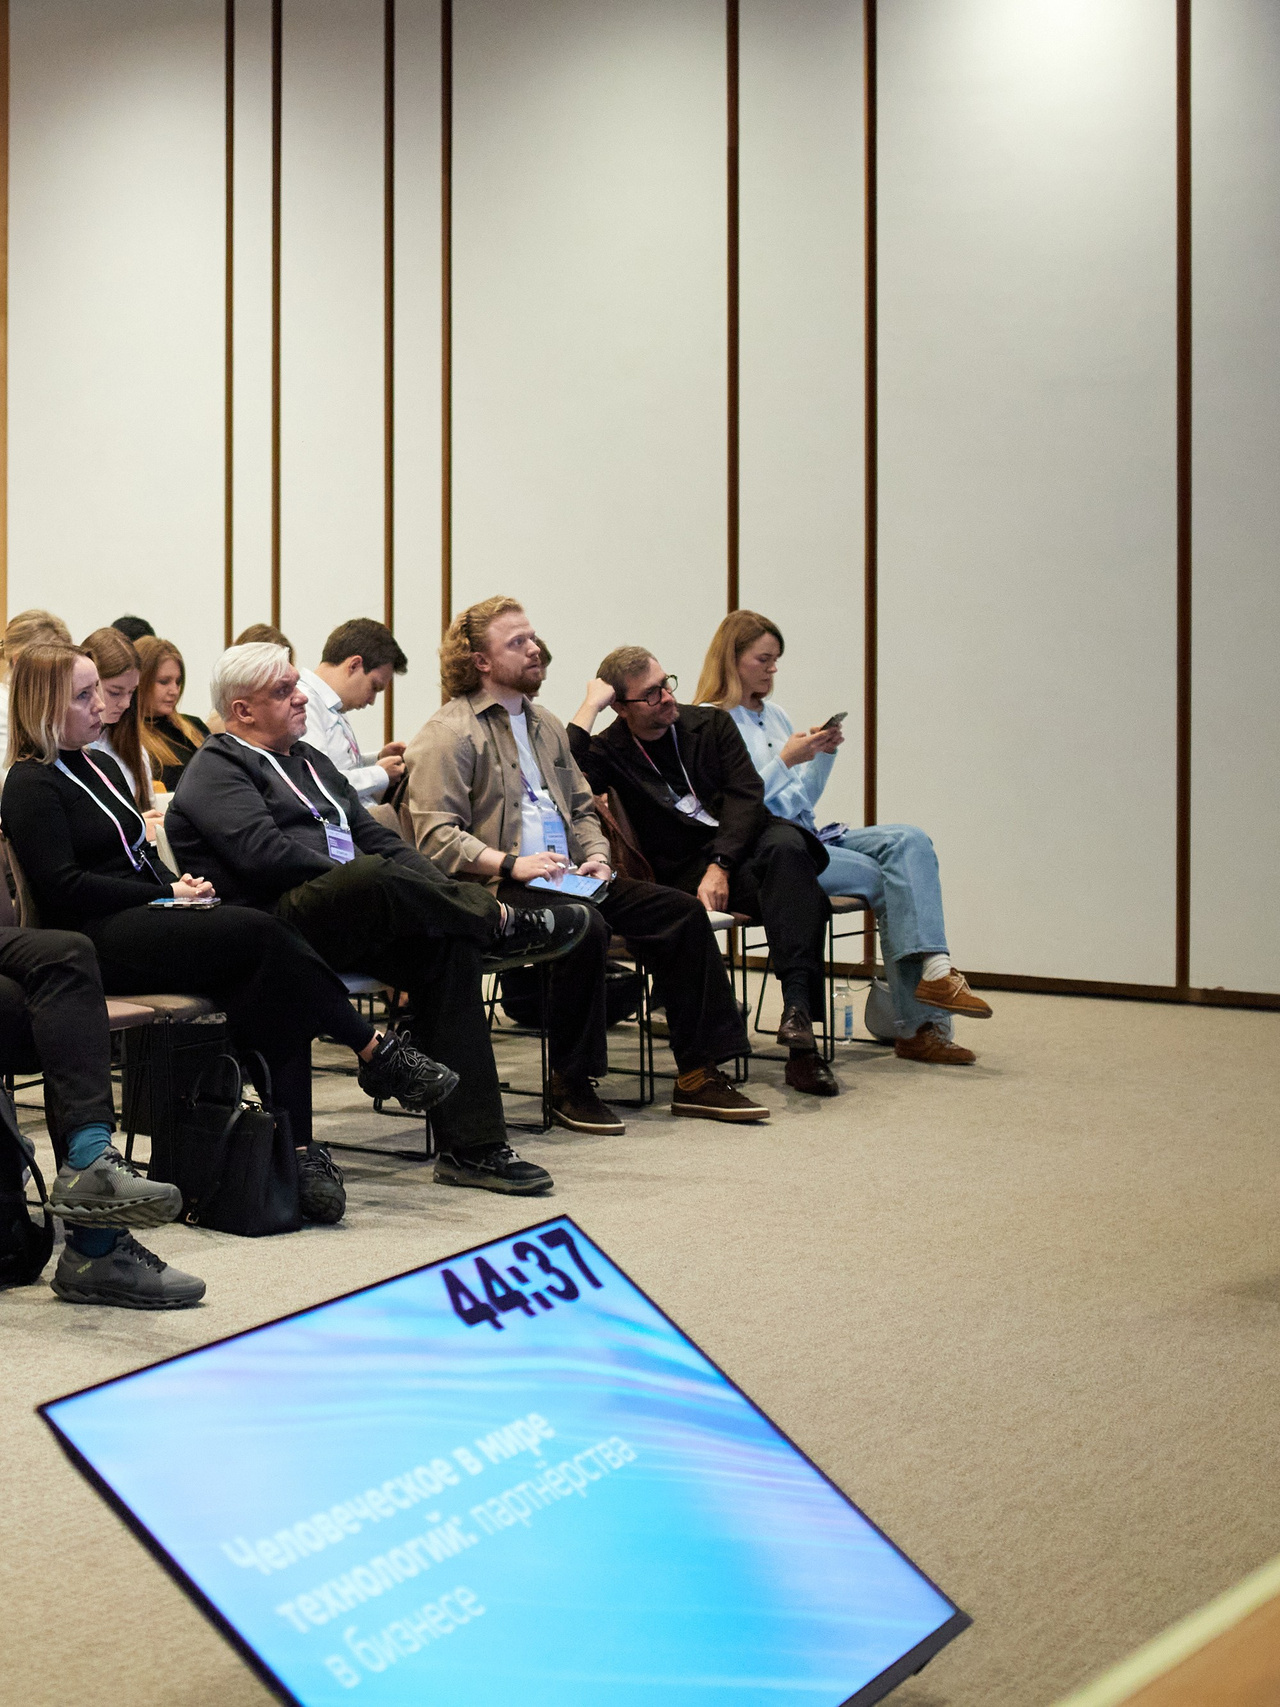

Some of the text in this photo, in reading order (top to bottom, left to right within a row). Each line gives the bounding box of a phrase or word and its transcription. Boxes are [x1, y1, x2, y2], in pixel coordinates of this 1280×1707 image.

[441, 1227, 604, 1332] 44:37
[220, 1412, 556, 1575] Человеческое в мире
[469, 1436, 638, 1535] партнёрства
[324, 1585, 486, 1689] в бизнесе
